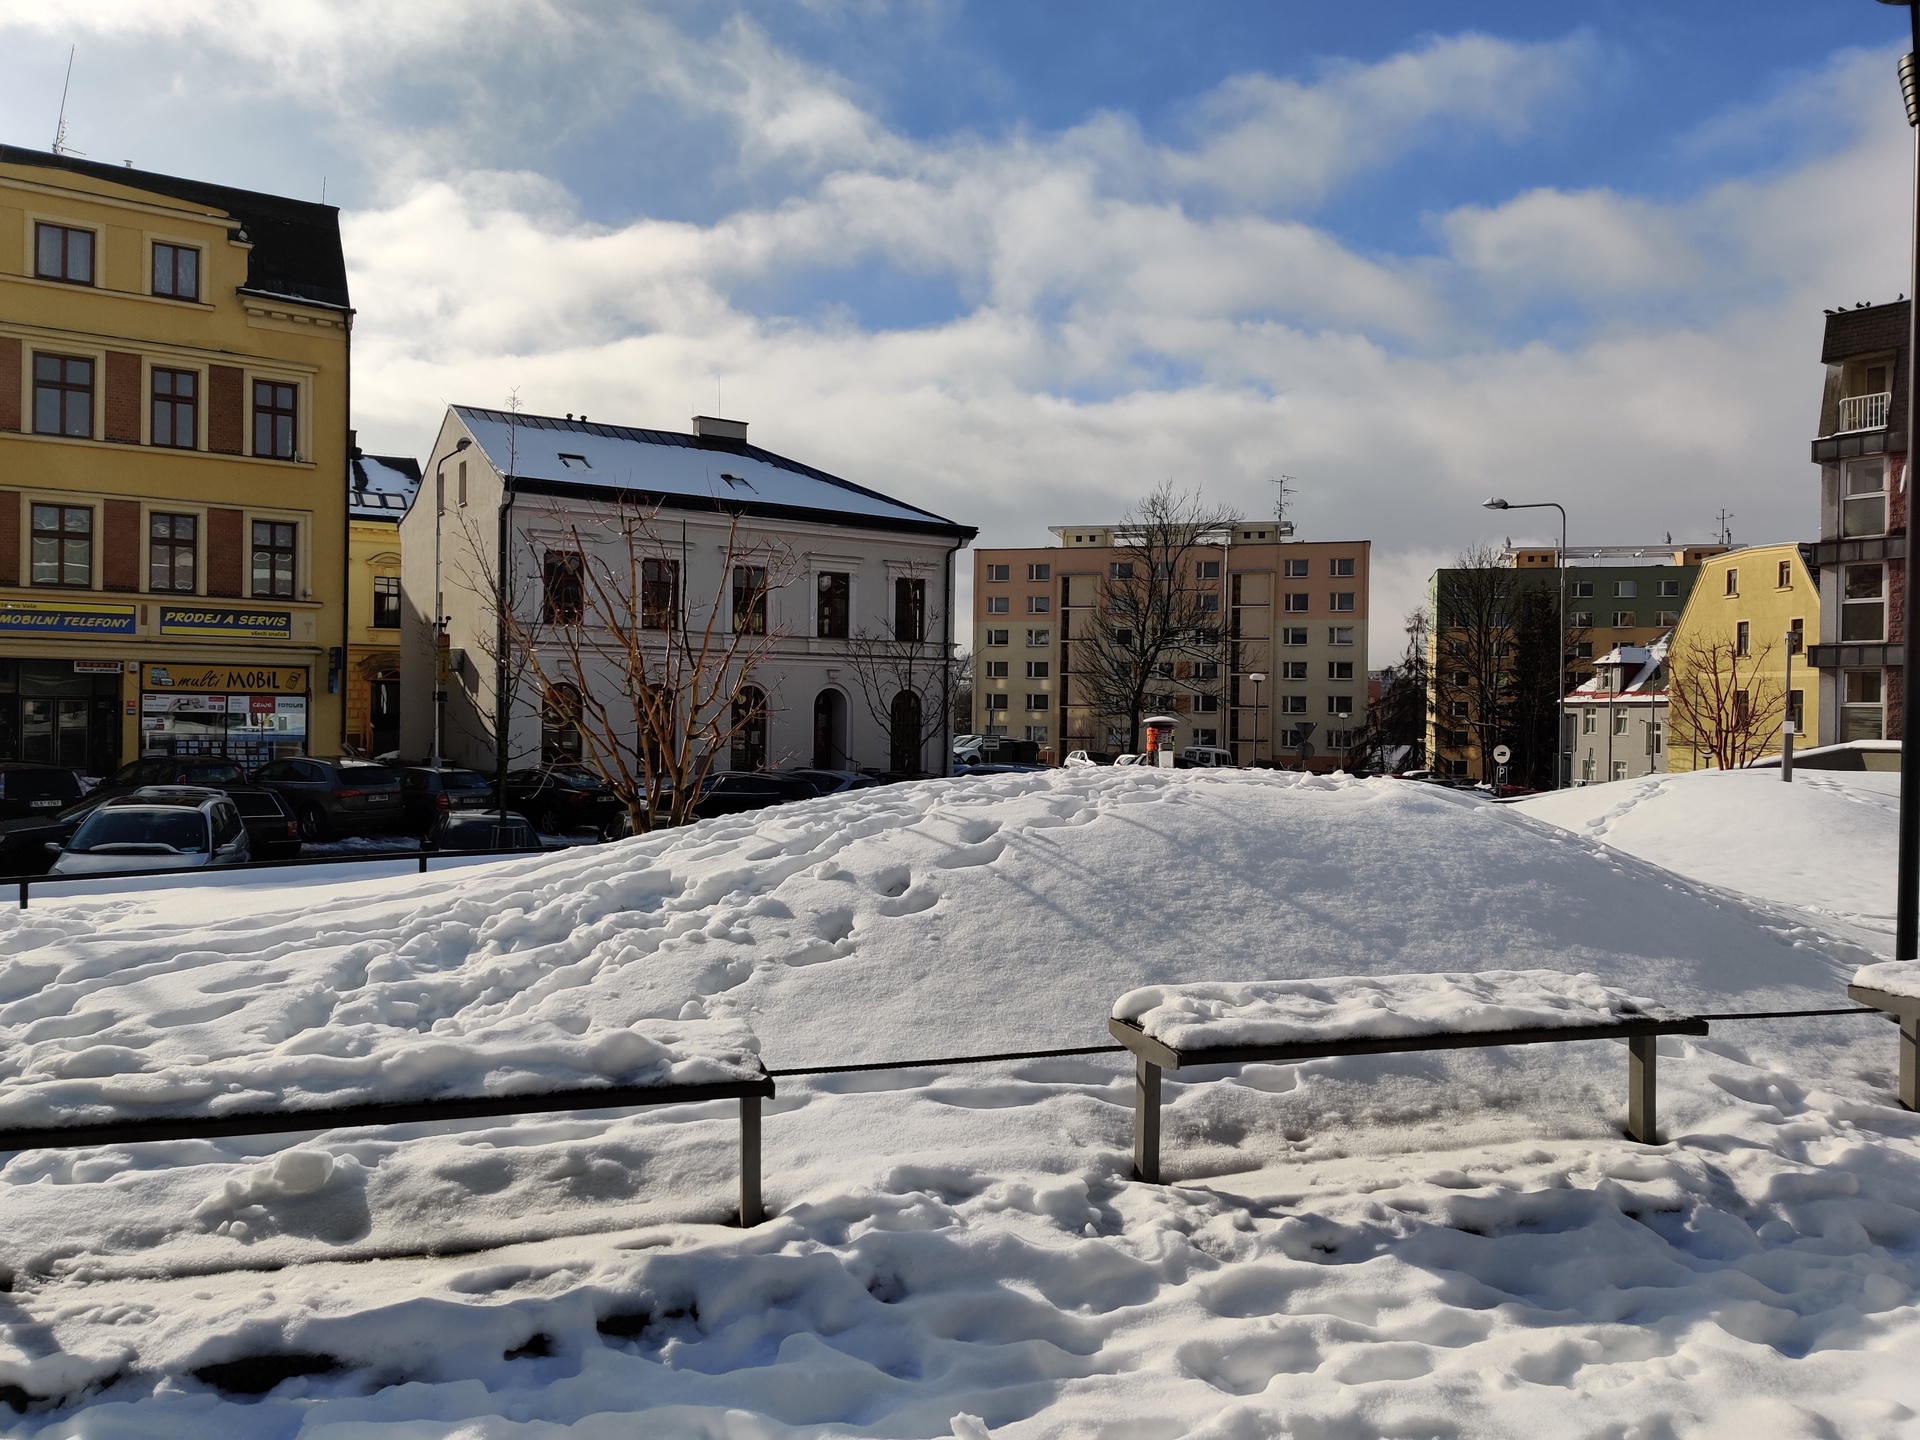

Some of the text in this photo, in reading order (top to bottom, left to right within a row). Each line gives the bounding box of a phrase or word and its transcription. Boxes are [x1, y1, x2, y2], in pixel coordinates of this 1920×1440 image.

[0, 613, 131, 628] MOBILNÍ TELEFONY
[164, 611, 287, 627] PRODEJ A SERVIS
[177, 669, 224, 688] multi
[1499, 767, 1505, 778] P
